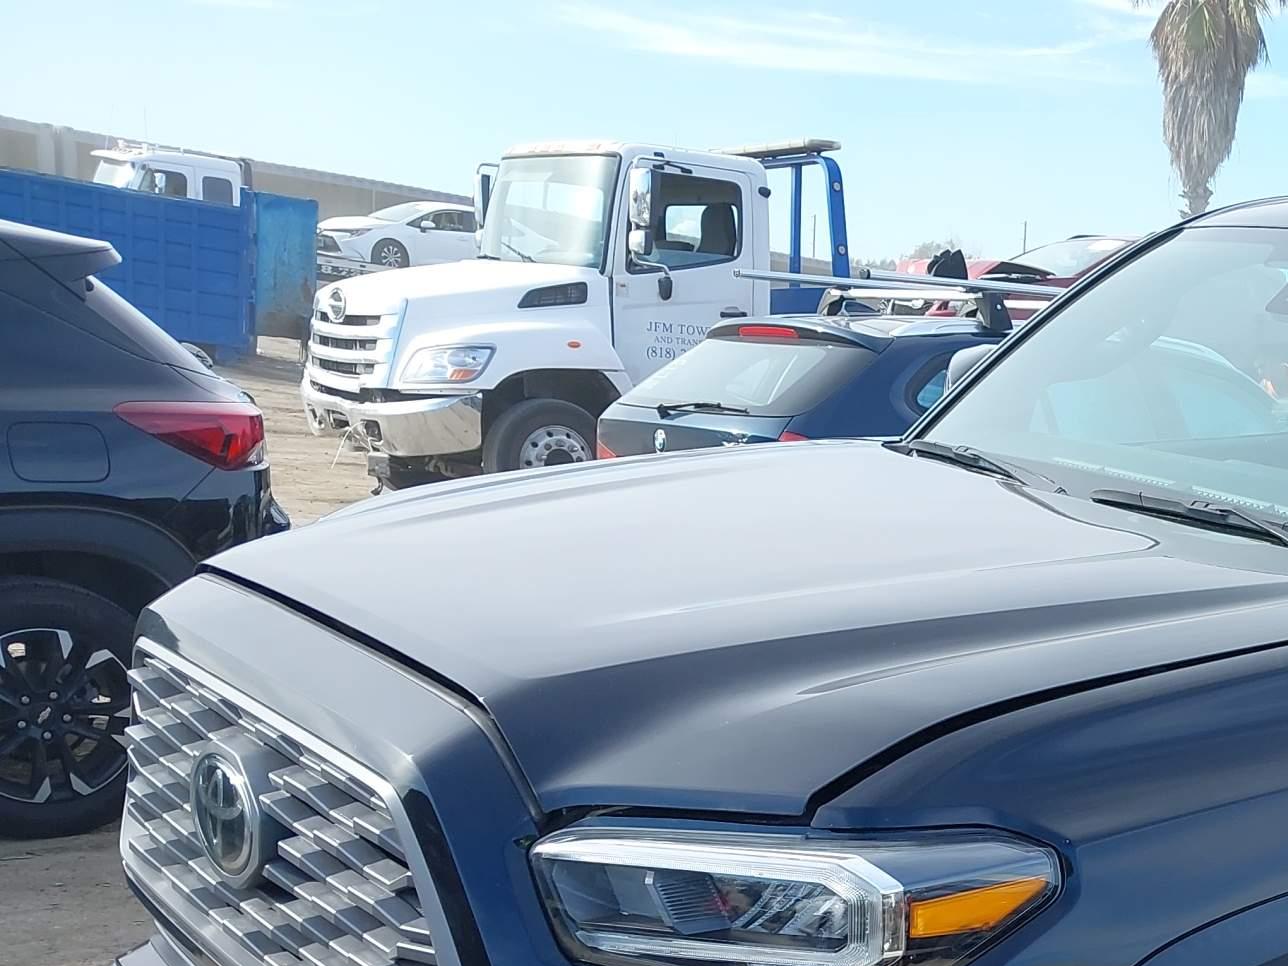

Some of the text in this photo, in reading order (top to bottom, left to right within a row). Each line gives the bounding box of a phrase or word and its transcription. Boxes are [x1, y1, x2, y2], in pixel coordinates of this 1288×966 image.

[646, 321, 711, 336] JFM TOW
[654, 335, 699, 346] AND TRAN
[646, 346, 676, 360] (818)
